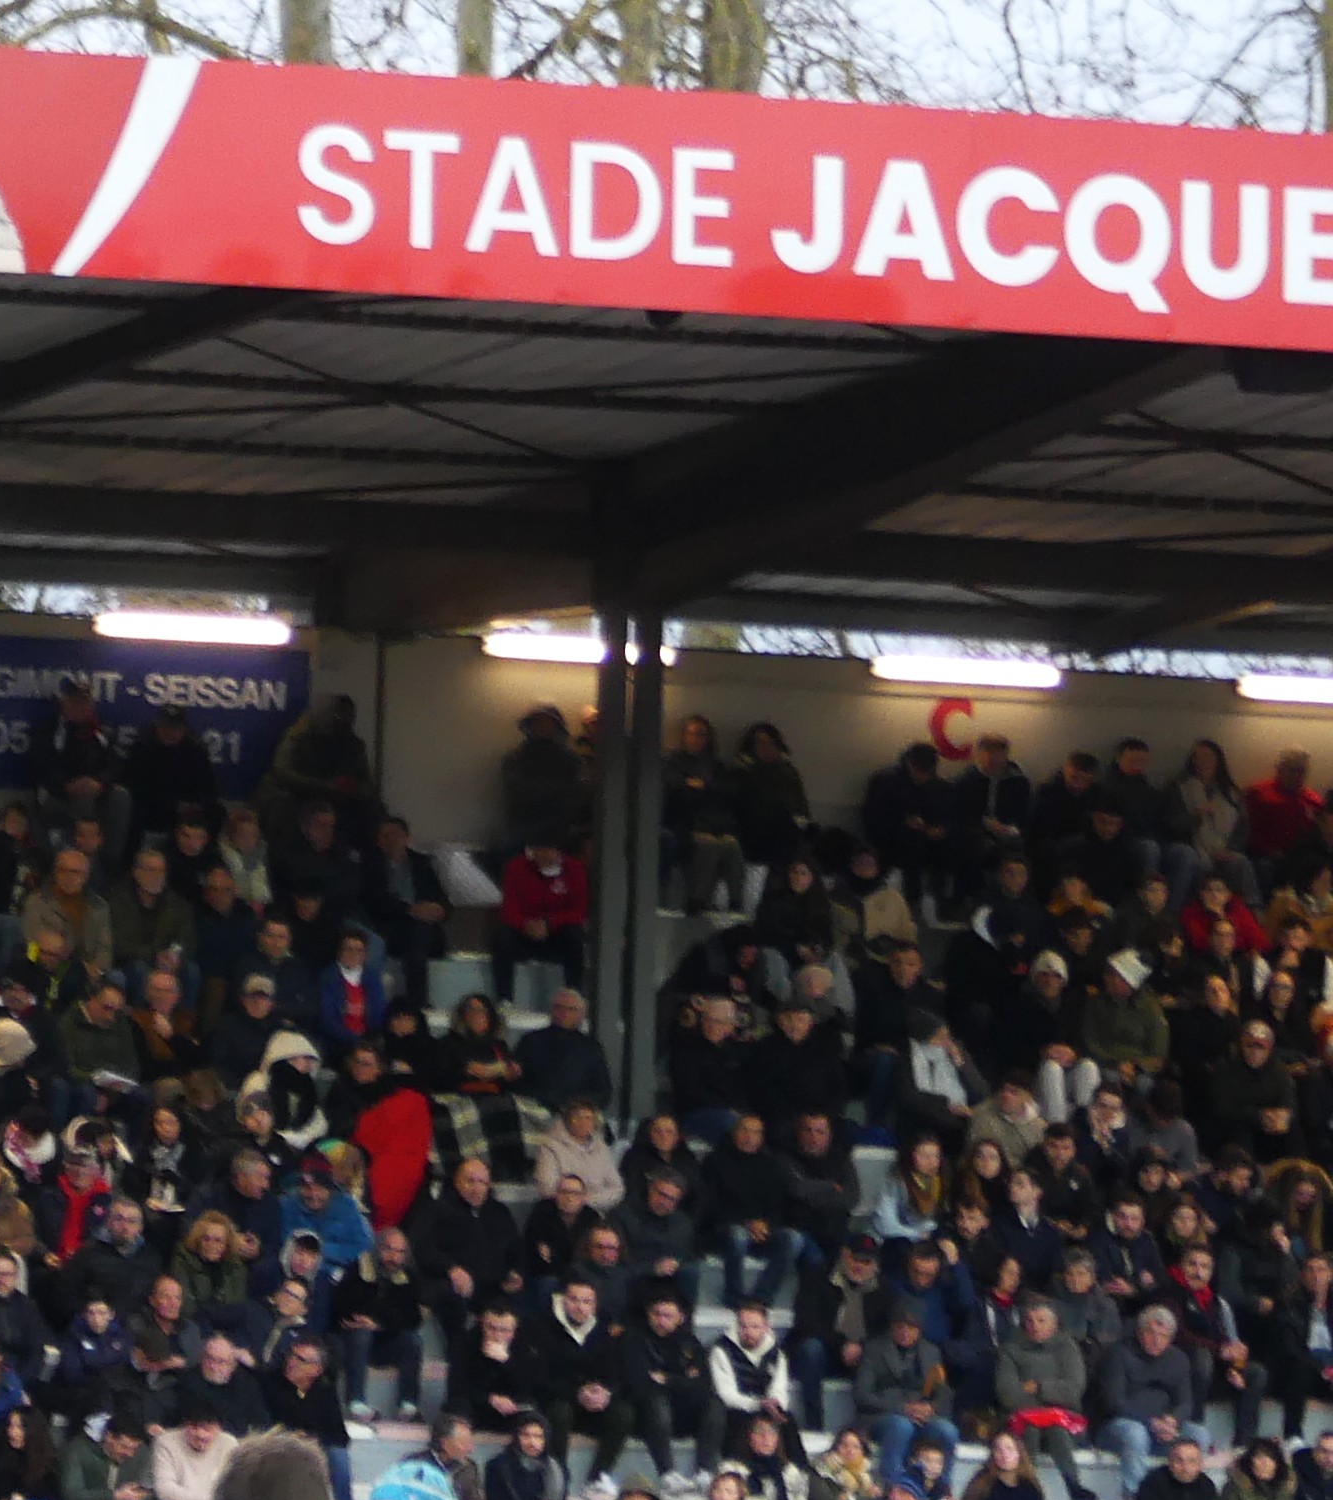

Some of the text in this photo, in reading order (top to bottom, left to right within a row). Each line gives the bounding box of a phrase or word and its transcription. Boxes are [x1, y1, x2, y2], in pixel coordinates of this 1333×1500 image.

[296, 122, 1333, 314] STADE JACQUE
[142, 672, 289, 711] SEISSAN
